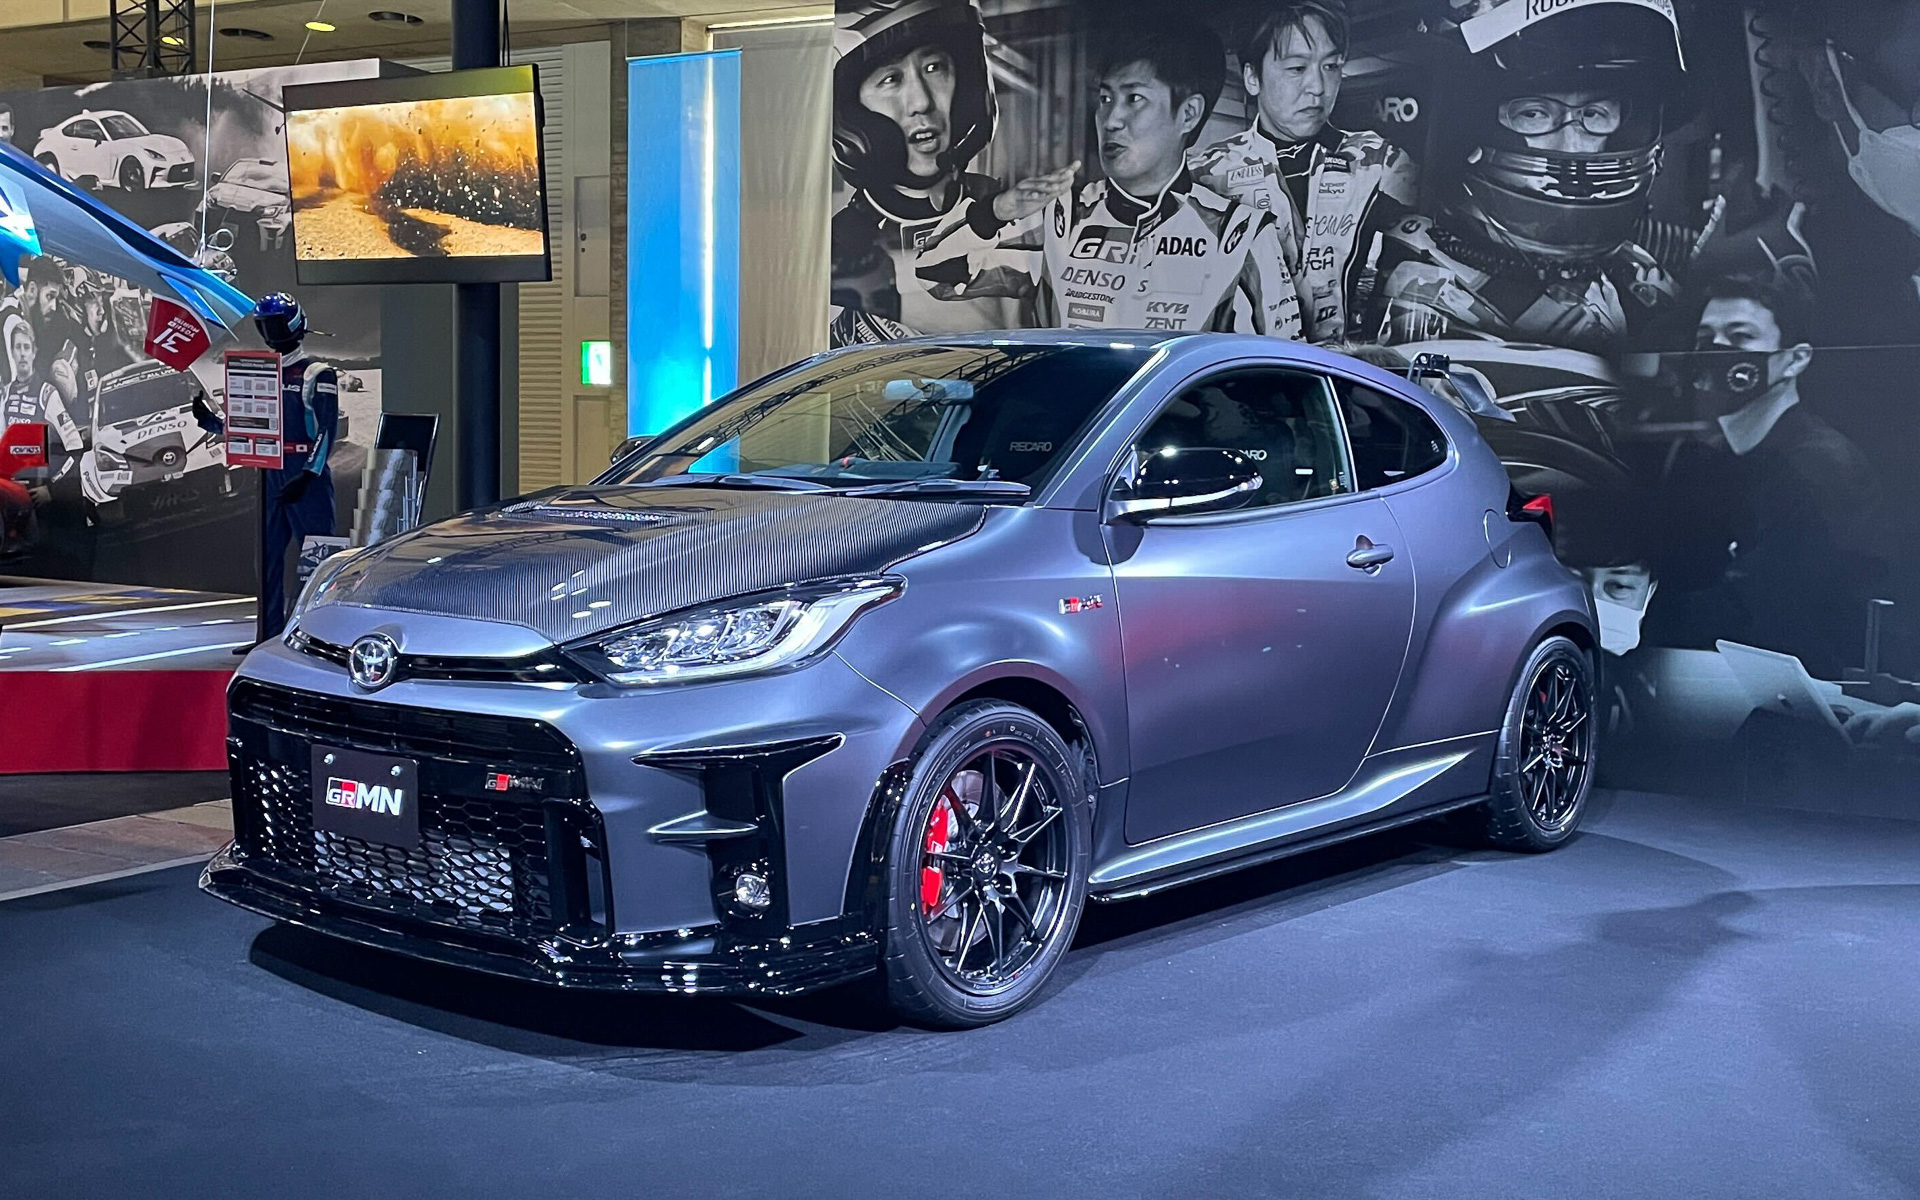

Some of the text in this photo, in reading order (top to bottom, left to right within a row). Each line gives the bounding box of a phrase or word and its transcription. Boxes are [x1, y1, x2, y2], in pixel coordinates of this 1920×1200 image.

[1156, 236, 1207, 258] ADAC
[1060, 266, 1126, 291] DENSO
[1145, 316, 1187, 330] ZENT
[137, 420, 187, 440] DENSO
[1010, 441, 1052, 452] RECARO
[1243, 449, 1267, 460] ARO
[326, 777, 403, 816] GRMN
